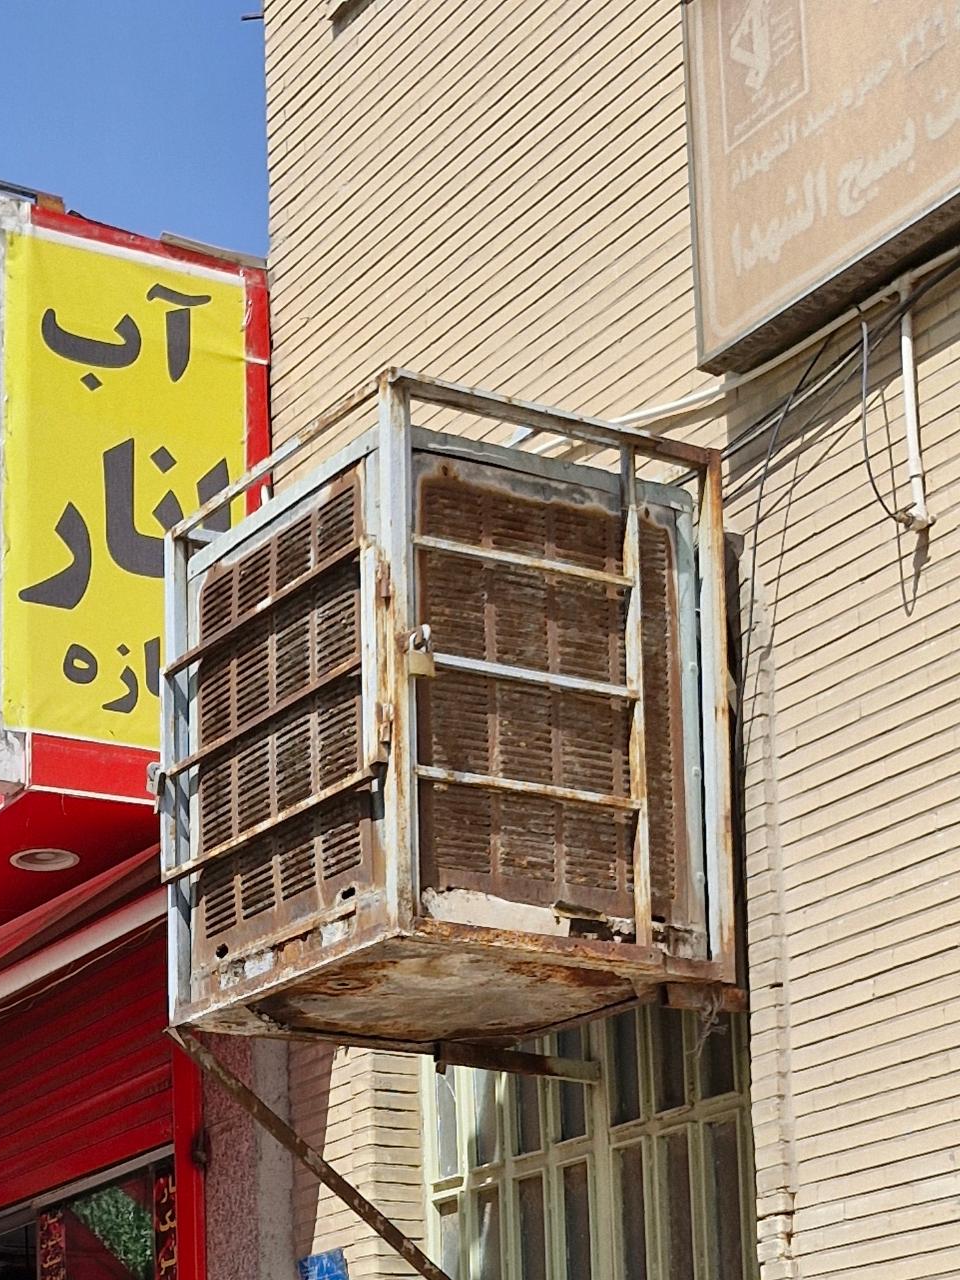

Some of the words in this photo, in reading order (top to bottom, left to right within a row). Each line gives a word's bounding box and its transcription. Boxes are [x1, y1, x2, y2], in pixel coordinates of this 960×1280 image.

[838, 117, 916, 216] بسیج
[40, 283, 211, 390] آب
[62, 637, 162, 713] ازه
